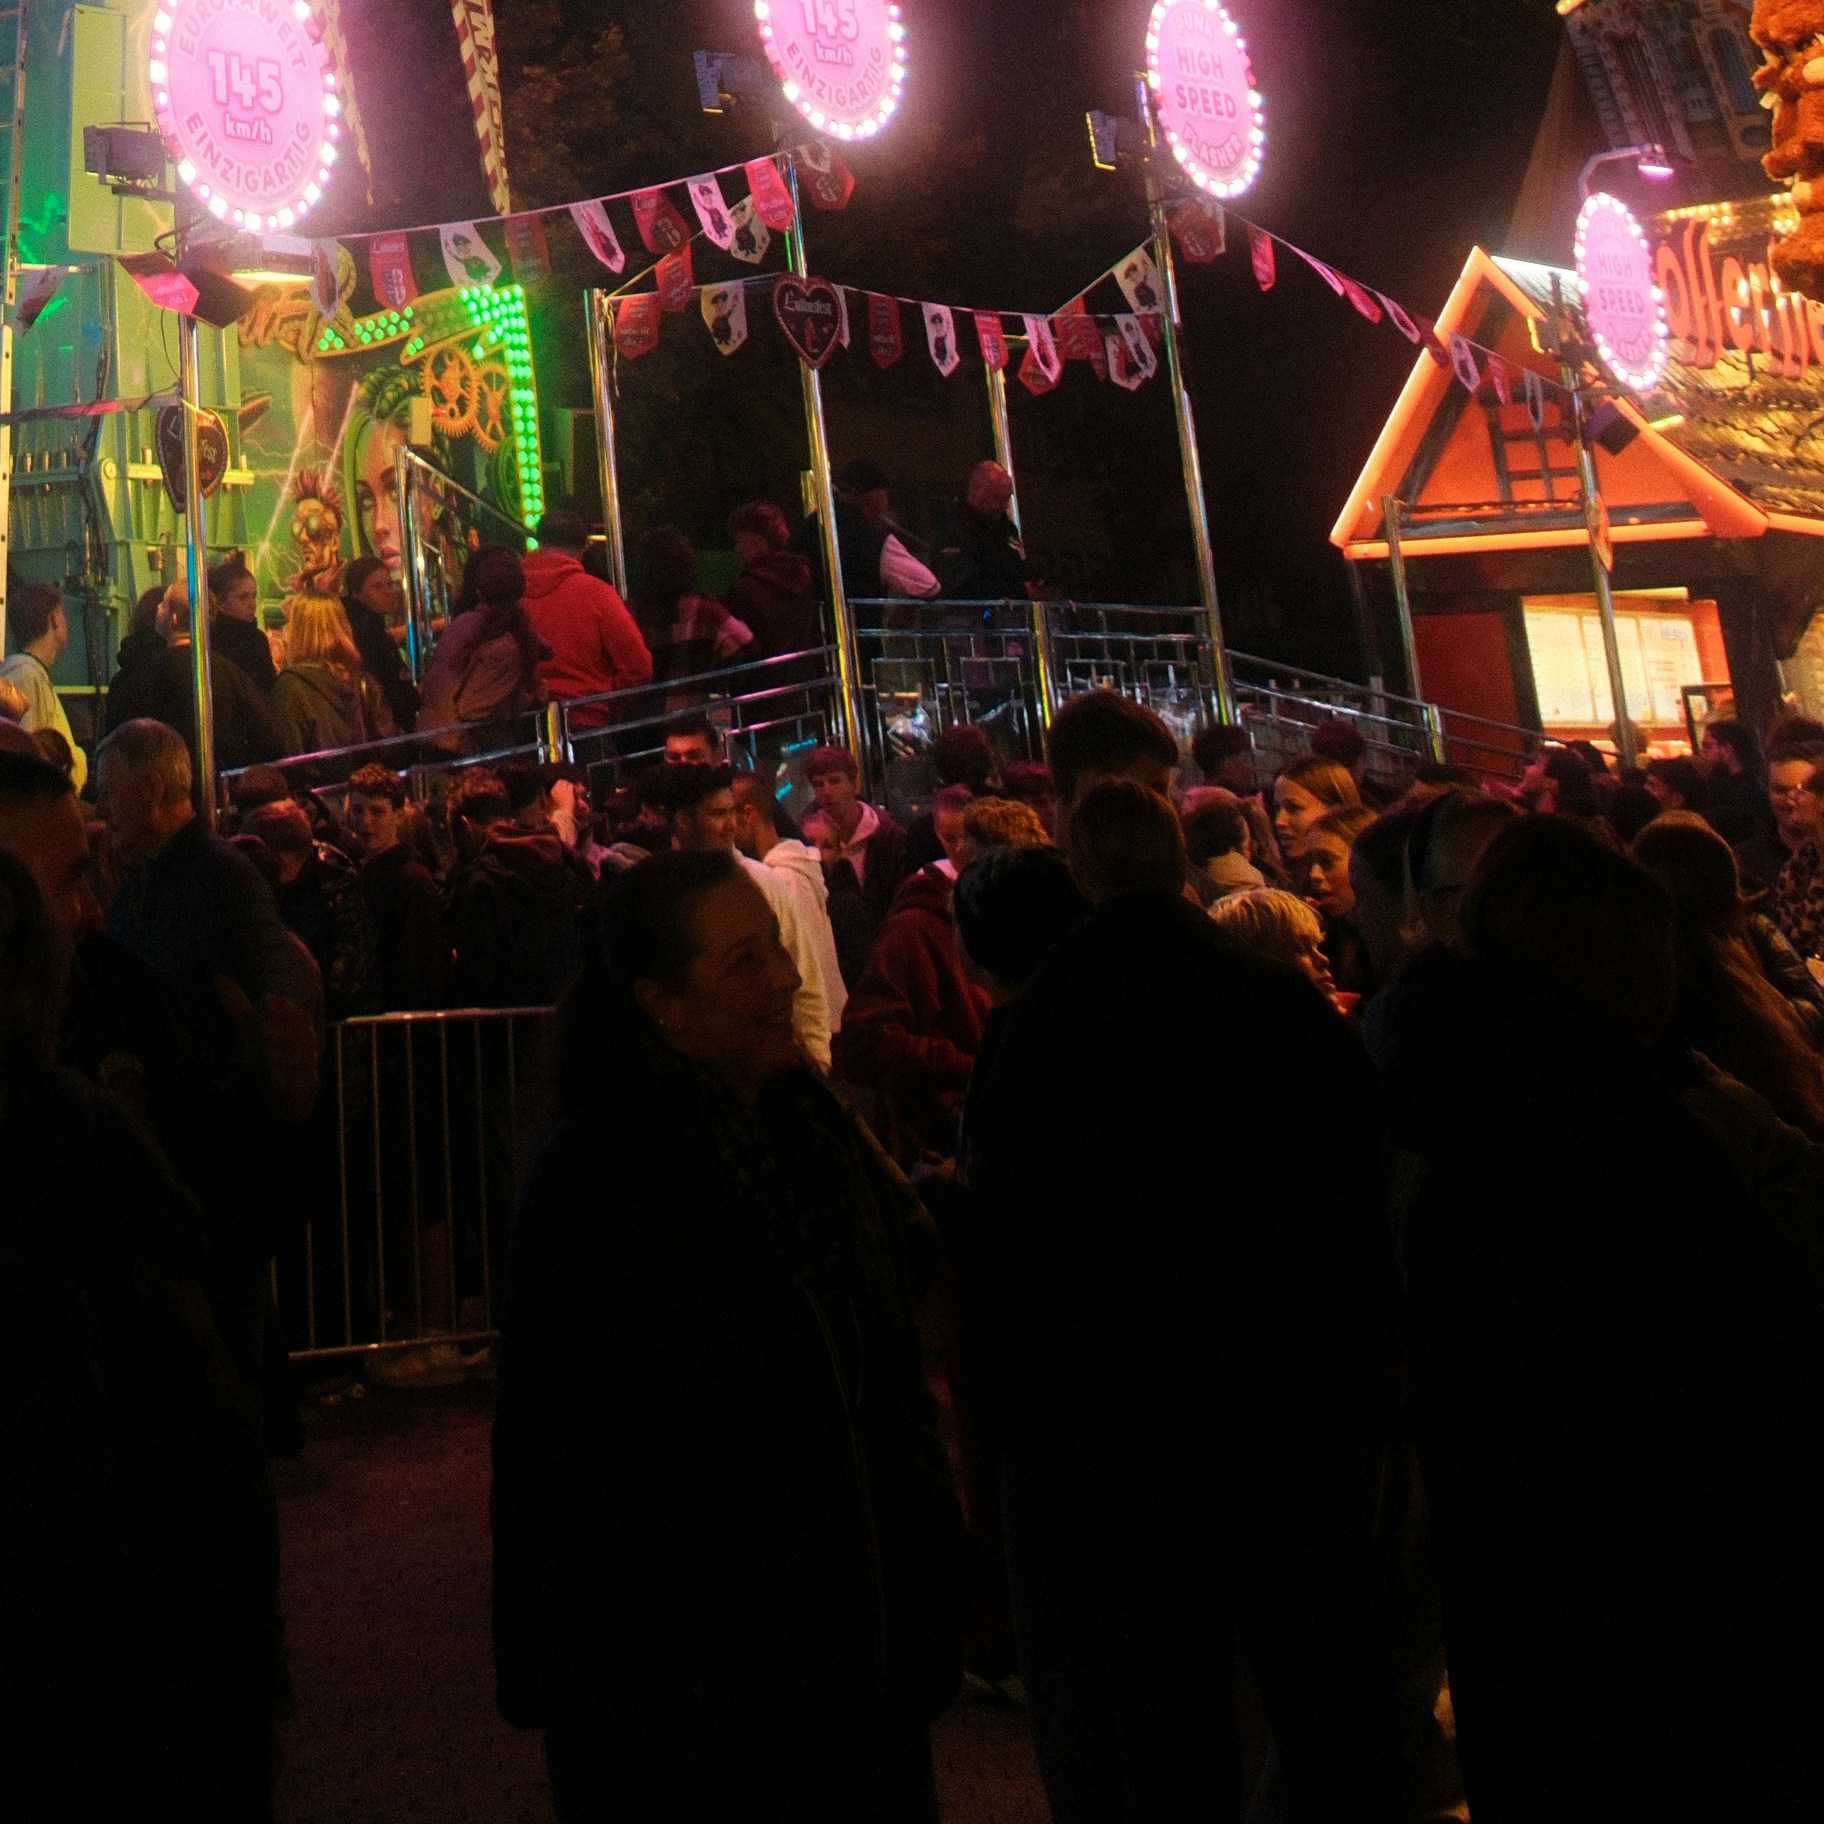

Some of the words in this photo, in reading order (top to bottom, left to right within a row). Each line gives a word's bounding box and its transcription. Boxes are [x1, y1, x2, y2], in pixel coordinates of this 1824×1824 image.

[814, 39, 854, 66] km/h
[1177, 46, 1225, 79] HIGH
[205, 49, 283, 116] 145
[787, 41, 882, 107] EINZIGARTIG
[1176, 83, 1237, 119] SPEED
[225, 112, 273, 146] km/h
[186, 111, 311, 194] EINZIGARTIG
[1598, 286, 1644, 314] SPEED
